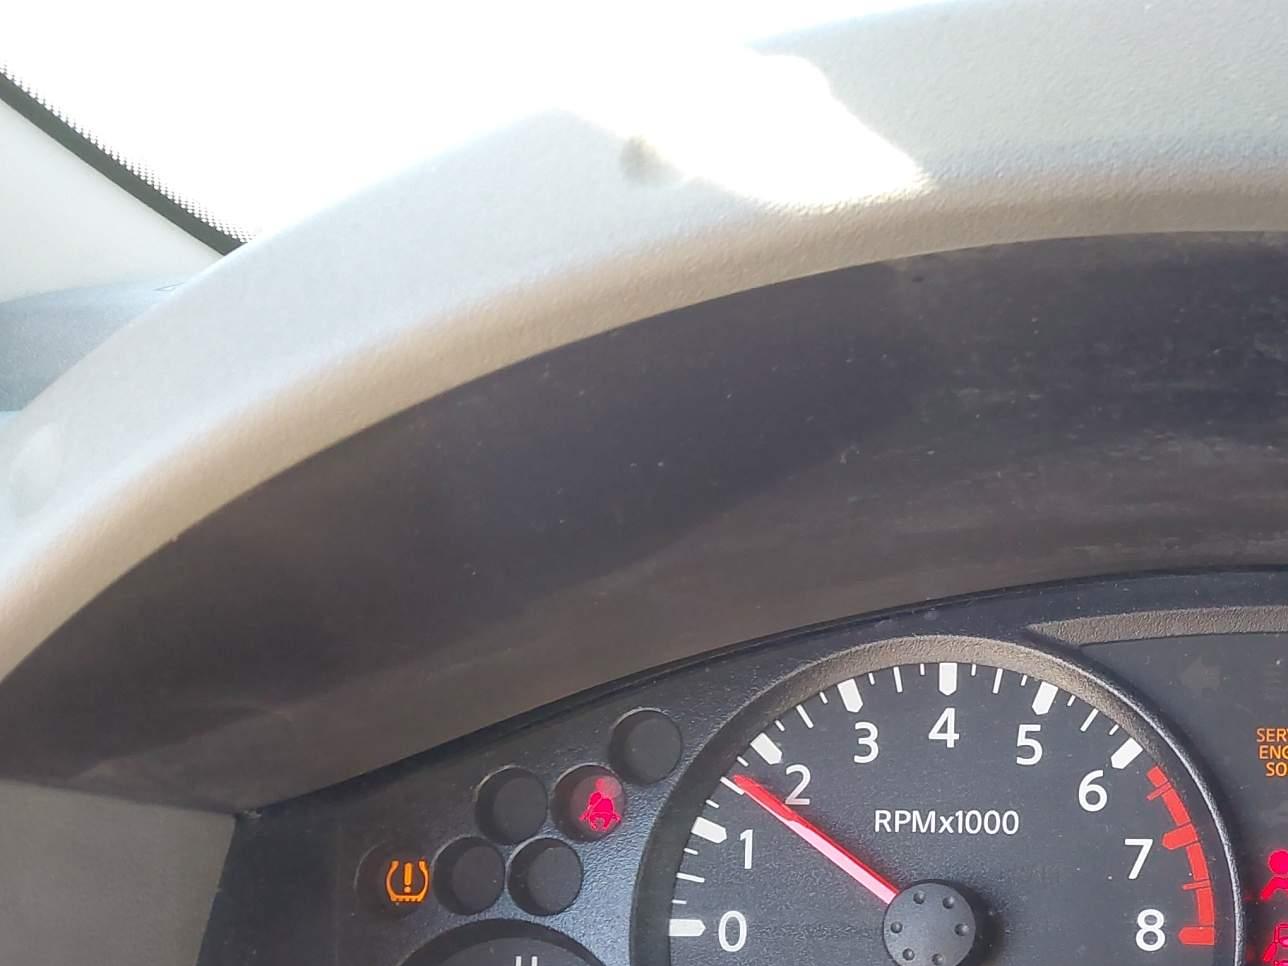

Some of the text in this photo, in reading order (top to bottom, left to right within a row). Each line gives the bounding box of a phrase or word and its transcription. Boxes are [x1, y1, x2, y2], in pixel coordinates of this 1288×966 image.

[853, 722, 879, 764] 3
[929, 708, 960, 748] 4
[1016, 724, 1043, 766] 5
[785, 764, 811, 806] 2
[1078, 769, 1108, 812] 6
[874, 809, 1019, 836] RPMx1000
[739, 829, 754, 870] 1
[1124, 838, 1154, 880] 7
[718, 910, 748, 953] 0
[1135, 908, 1166, 953] 8
